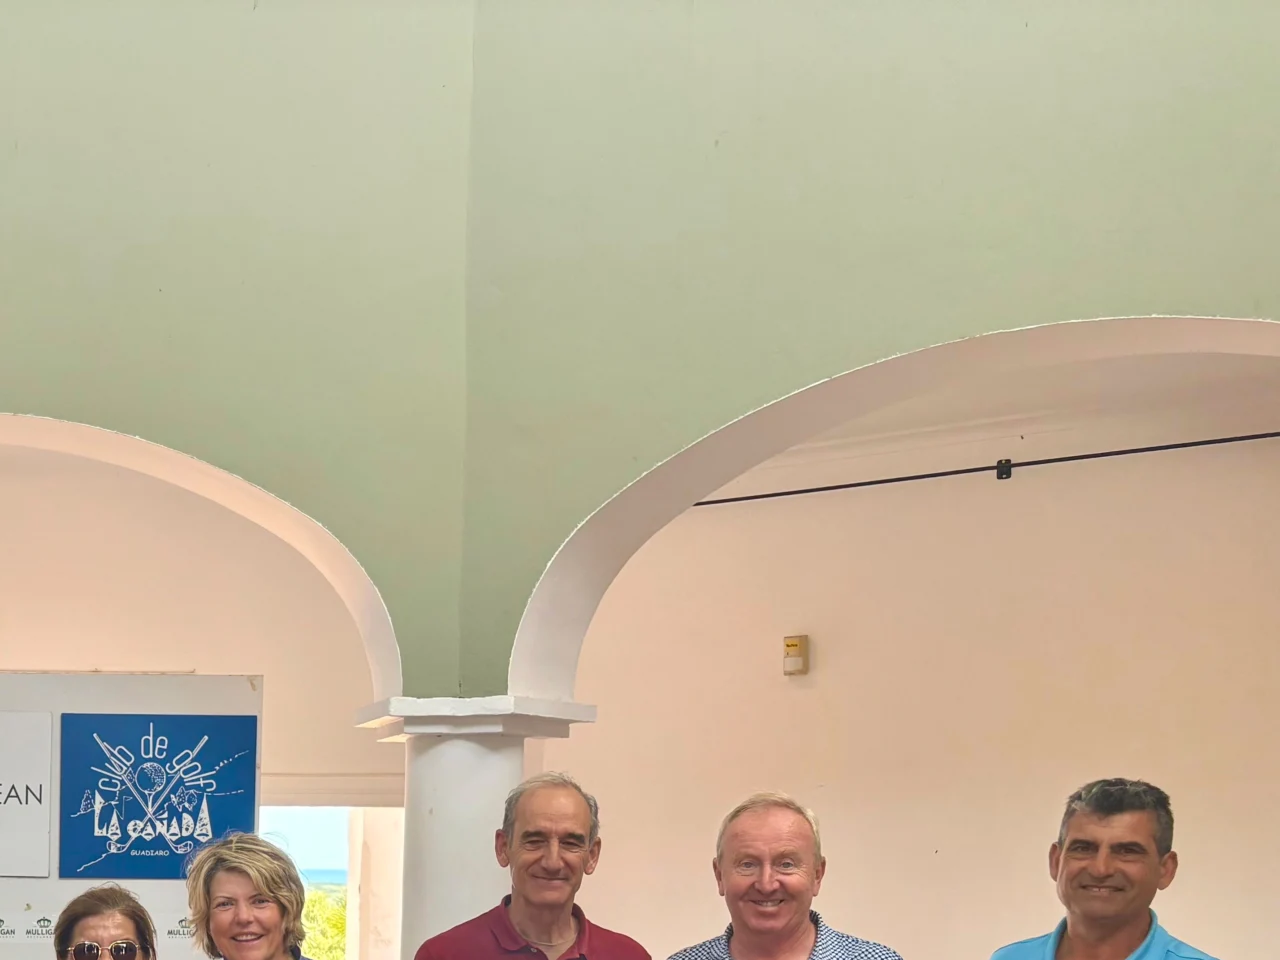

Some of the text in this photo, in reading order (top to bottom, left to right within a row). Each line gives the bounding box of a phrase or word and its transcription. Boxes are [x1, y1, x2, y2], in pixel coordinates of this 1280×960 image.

[141, 722, 168, 759] de
[91, 742, 134, 791] club
[166, 750, 216, 791] golf
